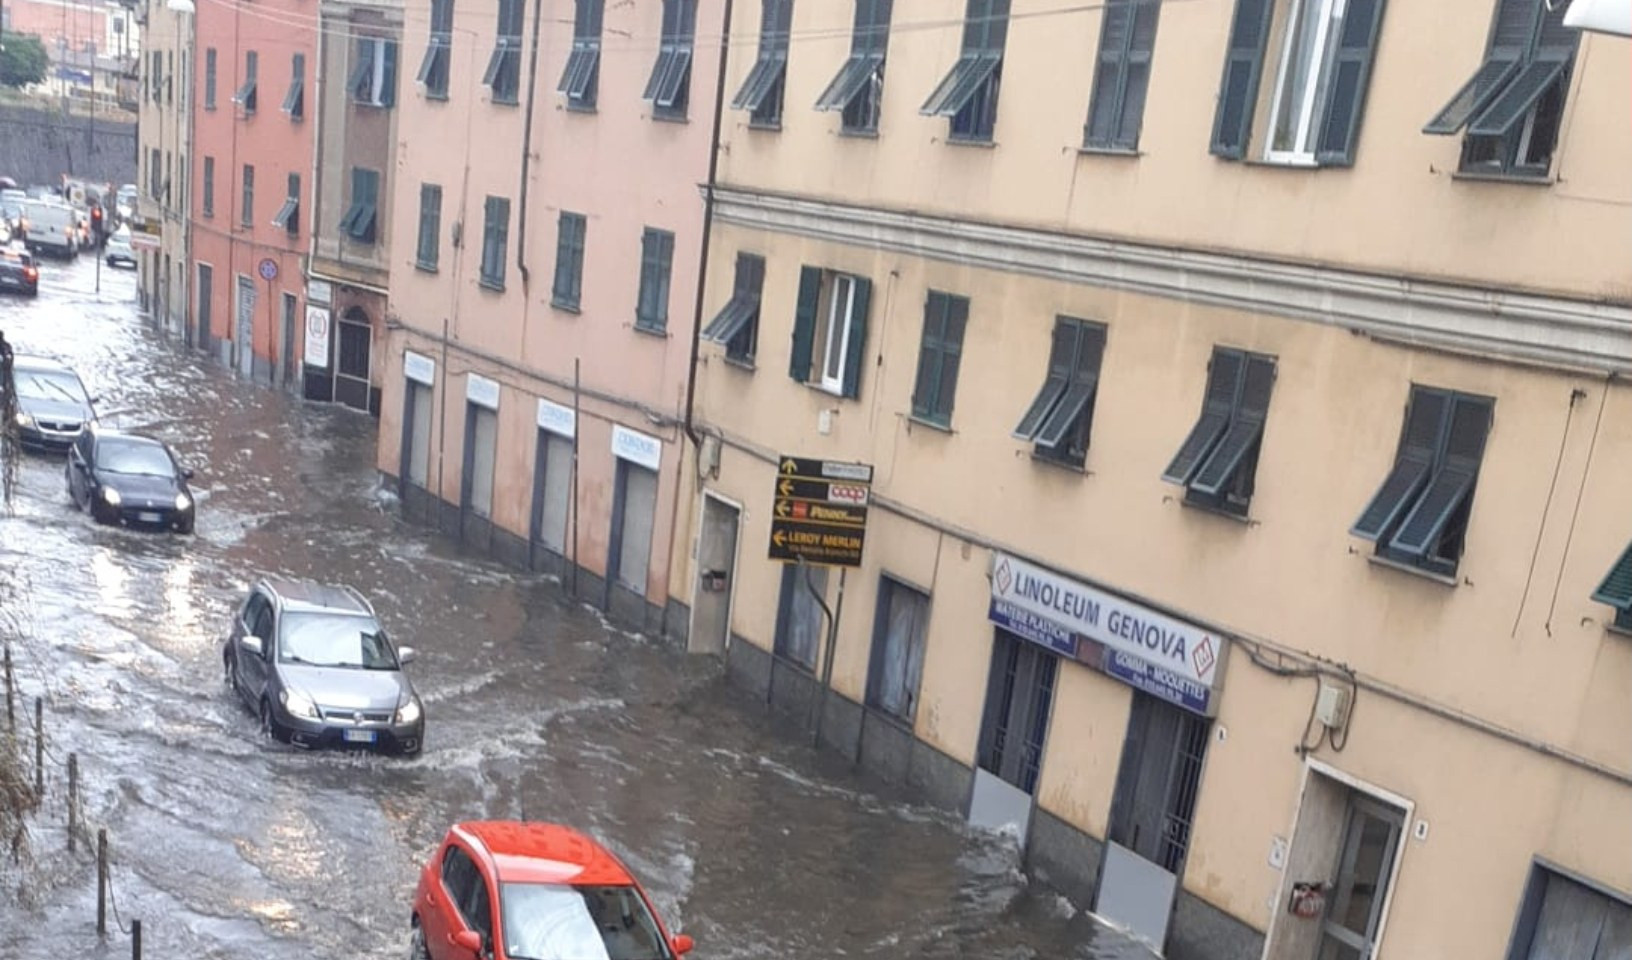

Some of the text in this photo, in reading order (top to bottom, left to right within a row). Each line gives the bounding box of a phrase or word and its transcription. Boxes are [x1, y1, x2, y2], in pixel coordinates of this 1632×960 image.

[832, 486, 865, 502] coop
[788, 531, 861, 549] LEROY MERLIN
[995, 601, 1030, 623] MATERIE
[1015, 571, 1101, 626] LINOLEUM
[1107, 609, 1186, 662] GENOVA
[1115, 651, 1147, 679] GOMMA
[1153, 667, 1205, 700] MOQUETTES
